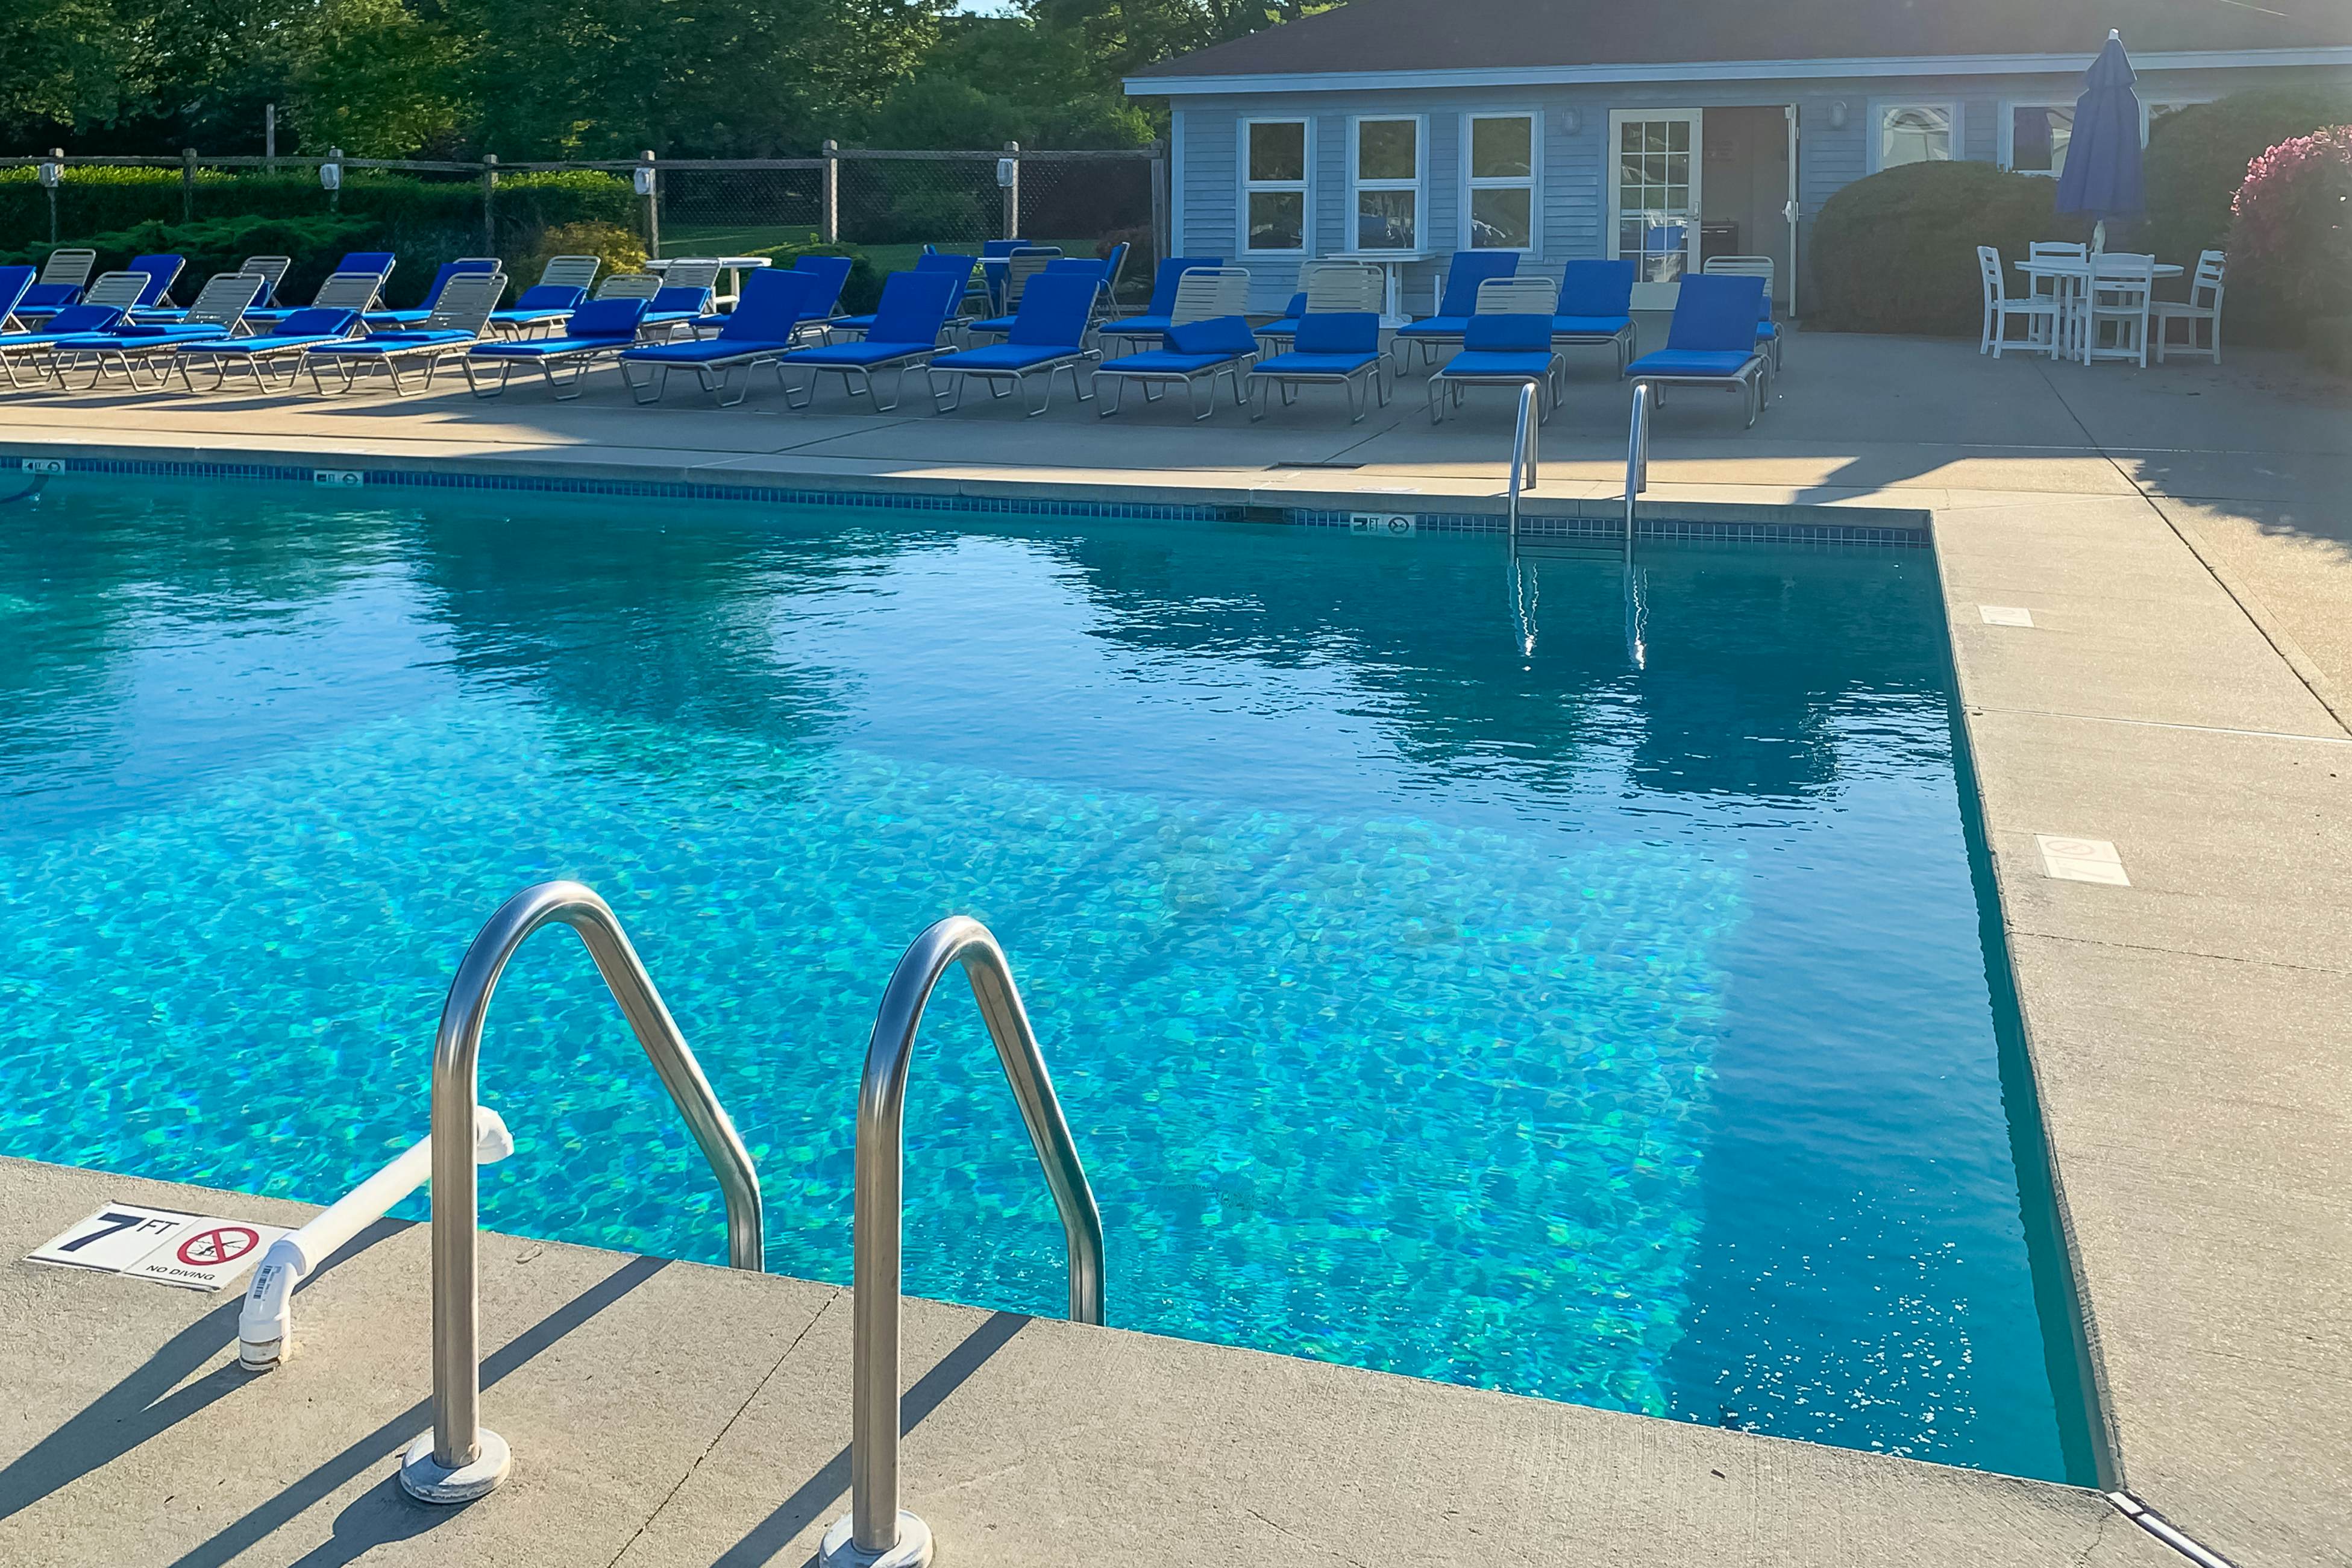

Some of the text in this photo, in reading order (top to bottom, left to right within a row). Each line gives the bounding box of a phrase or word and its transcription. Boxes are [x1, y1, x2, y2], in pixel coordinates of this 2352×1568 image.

[57, 1212, 180, 1252] 7 FT
[169, 1269, 215, 1280] DIVING
